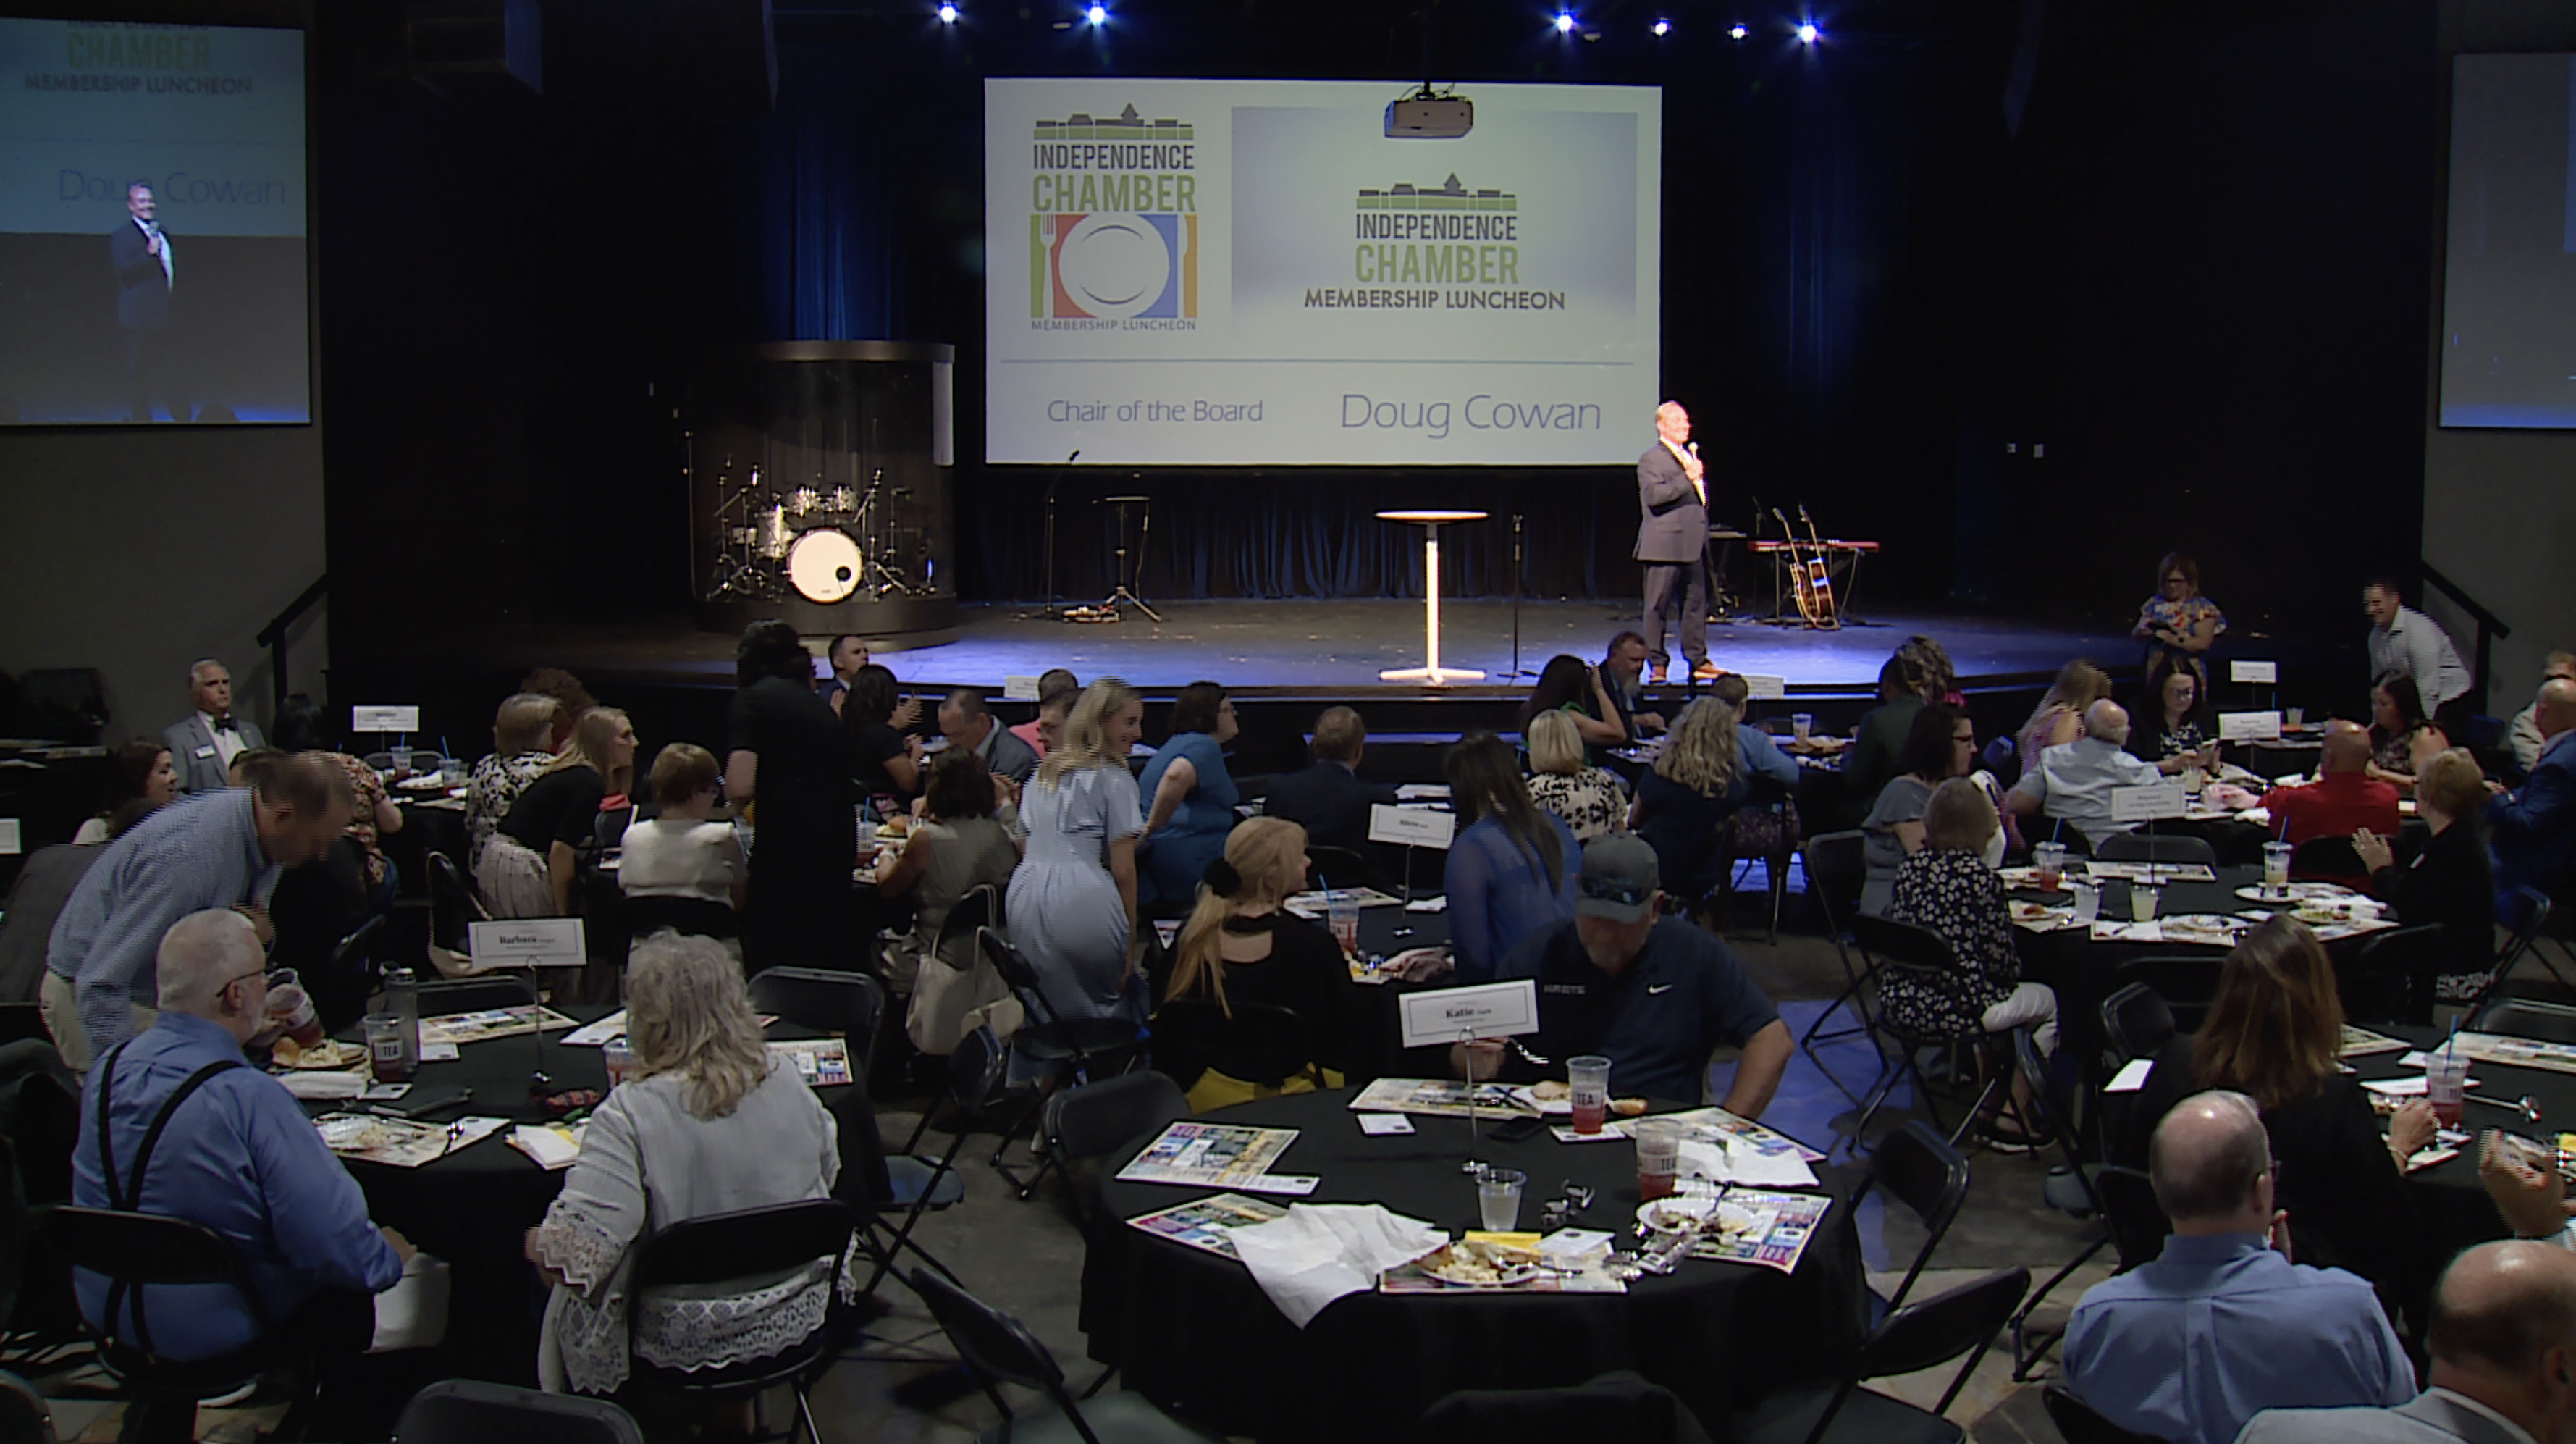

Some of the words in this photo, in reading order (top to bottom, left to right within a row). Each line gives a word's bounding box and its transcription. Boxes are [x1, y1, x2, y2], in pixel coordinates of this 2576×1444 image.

[67, 32, 210, 70] CHAMBER
[25, 74, 141, 92] MEMBERSHIP
[146, 77, 253, 94] LUNCHEON
[1034, 144, 1194, 169] INDEPENDENCE
[165, 172, 285, 204] Cowan
[1033, 174, 1195, 211] CHAMBER
[1356, 214, 1517, 240] INDEPENDENCE
[1355, 244, 1518, 283] CHAMBER
[1304, 289, 1439, 308] MEMBERSHIP
[1446, 292, 1565, 310] LUNCHEON
[1032, 319, 1118, 330] MEMBERSHIP
[1122, 319, 1197, 331] LUNCHEON
[1048, 400, 1110, 422] Chair
[1117, 400, 1141, 422] of
[1148, 401, 1185, 422] the
[1194, 400, 1263, 422] Board
[1342, 394, 1450, 439] Doug
[1465, 394, 1601, 429] Cowan
[500, 935, 537, 944] Barbara
[1446, 1007, 1474, 1018] Katie
[383, 1045, 398, 1057] TEA
[1577, 1093, 1594, 1106] TEA
